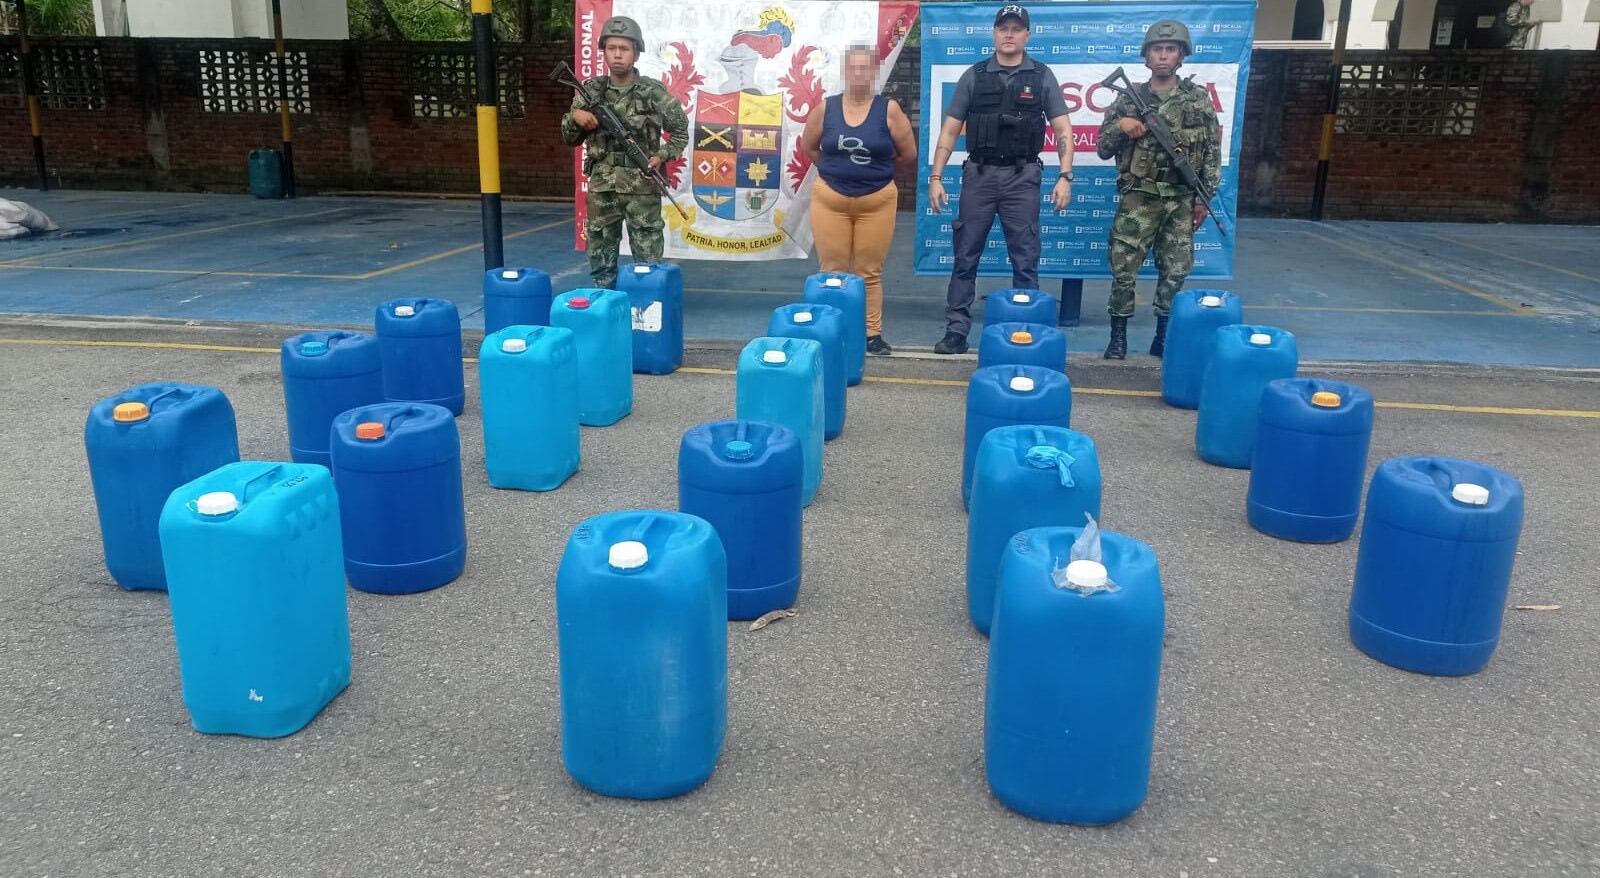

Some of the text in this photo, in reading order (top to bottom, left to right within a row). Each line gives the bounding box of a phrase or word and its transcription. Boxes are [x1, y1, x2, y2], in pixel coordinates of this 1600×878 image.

[581, 10, 593, 84] CIONAL
[686, 232, 782, 250] PATRIA, HONOR, LEALTAD
